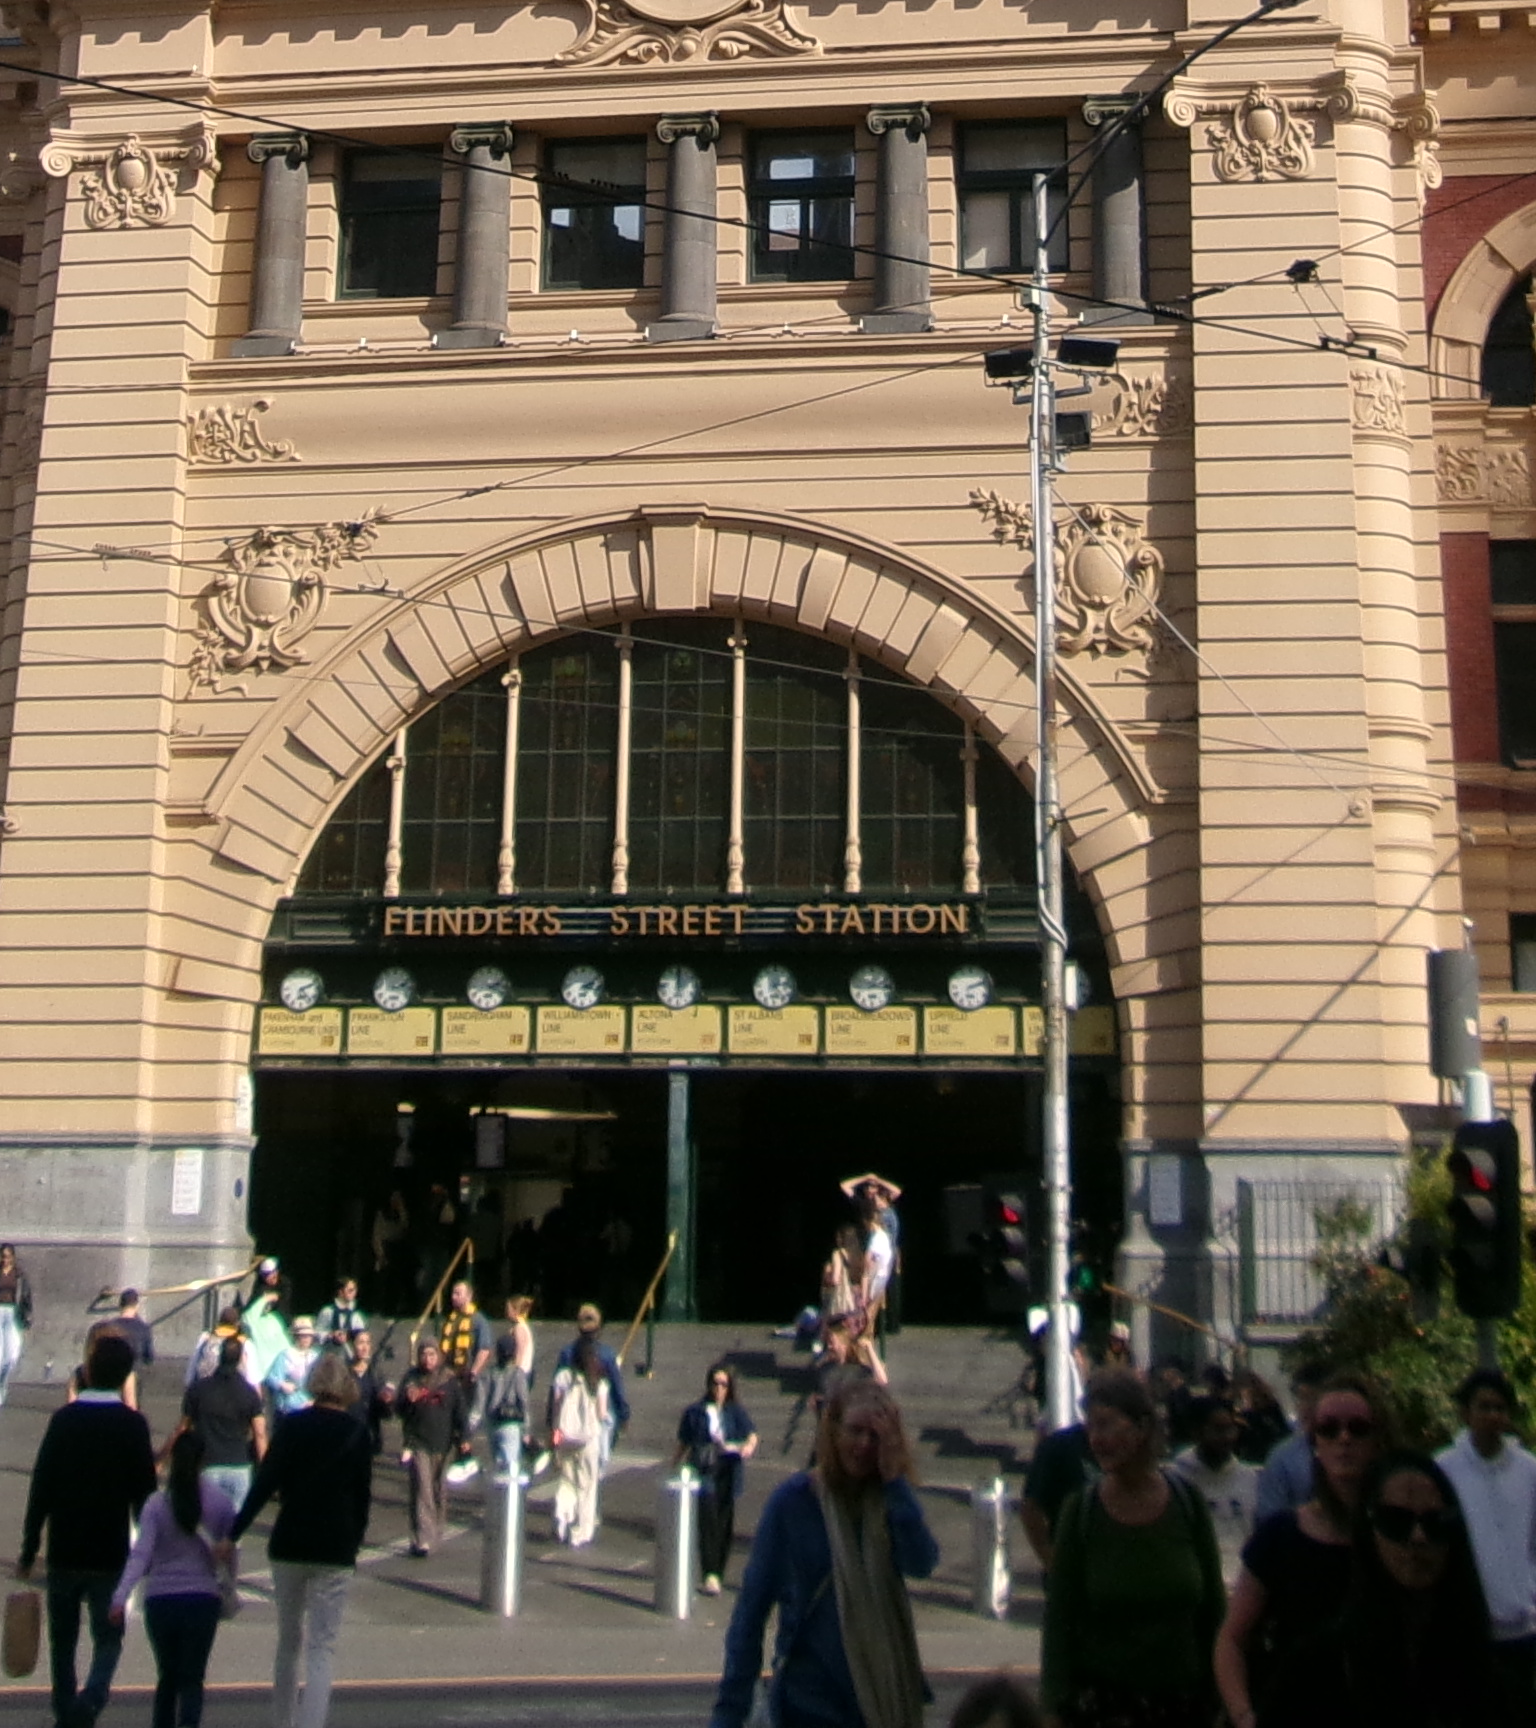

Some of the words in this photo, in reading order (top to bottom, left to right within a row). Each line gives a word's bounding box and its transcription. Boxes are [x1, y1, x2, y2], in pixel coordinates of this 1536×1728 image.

[384, 905, 562, 936] FLINDERS
[610, 904, 749, 936] STREET
[796, 903, 970, 934] STATION
[446, 1010, 513, 1021] SANDRINGHAM
[543, 1010, 611, 1020] WILLIAMSTOWN
[638, 1010, 673, 1019] ALTONA
[734, 1010, 745, 1020] ST
[747, 1010, 783, 1020] ALBANS
[351, 1025, 370, 1036] LINE
[446, 1024, 466, 1034] LINE
[542, 1023, 561, 1033] LINE
[637, 1022, 657, 1032] LINE
[734, 1023, 753, 1033] LINE
[831, 1024, 852, 1034] LINE
[930, 1024, 950, 1034] LINE
